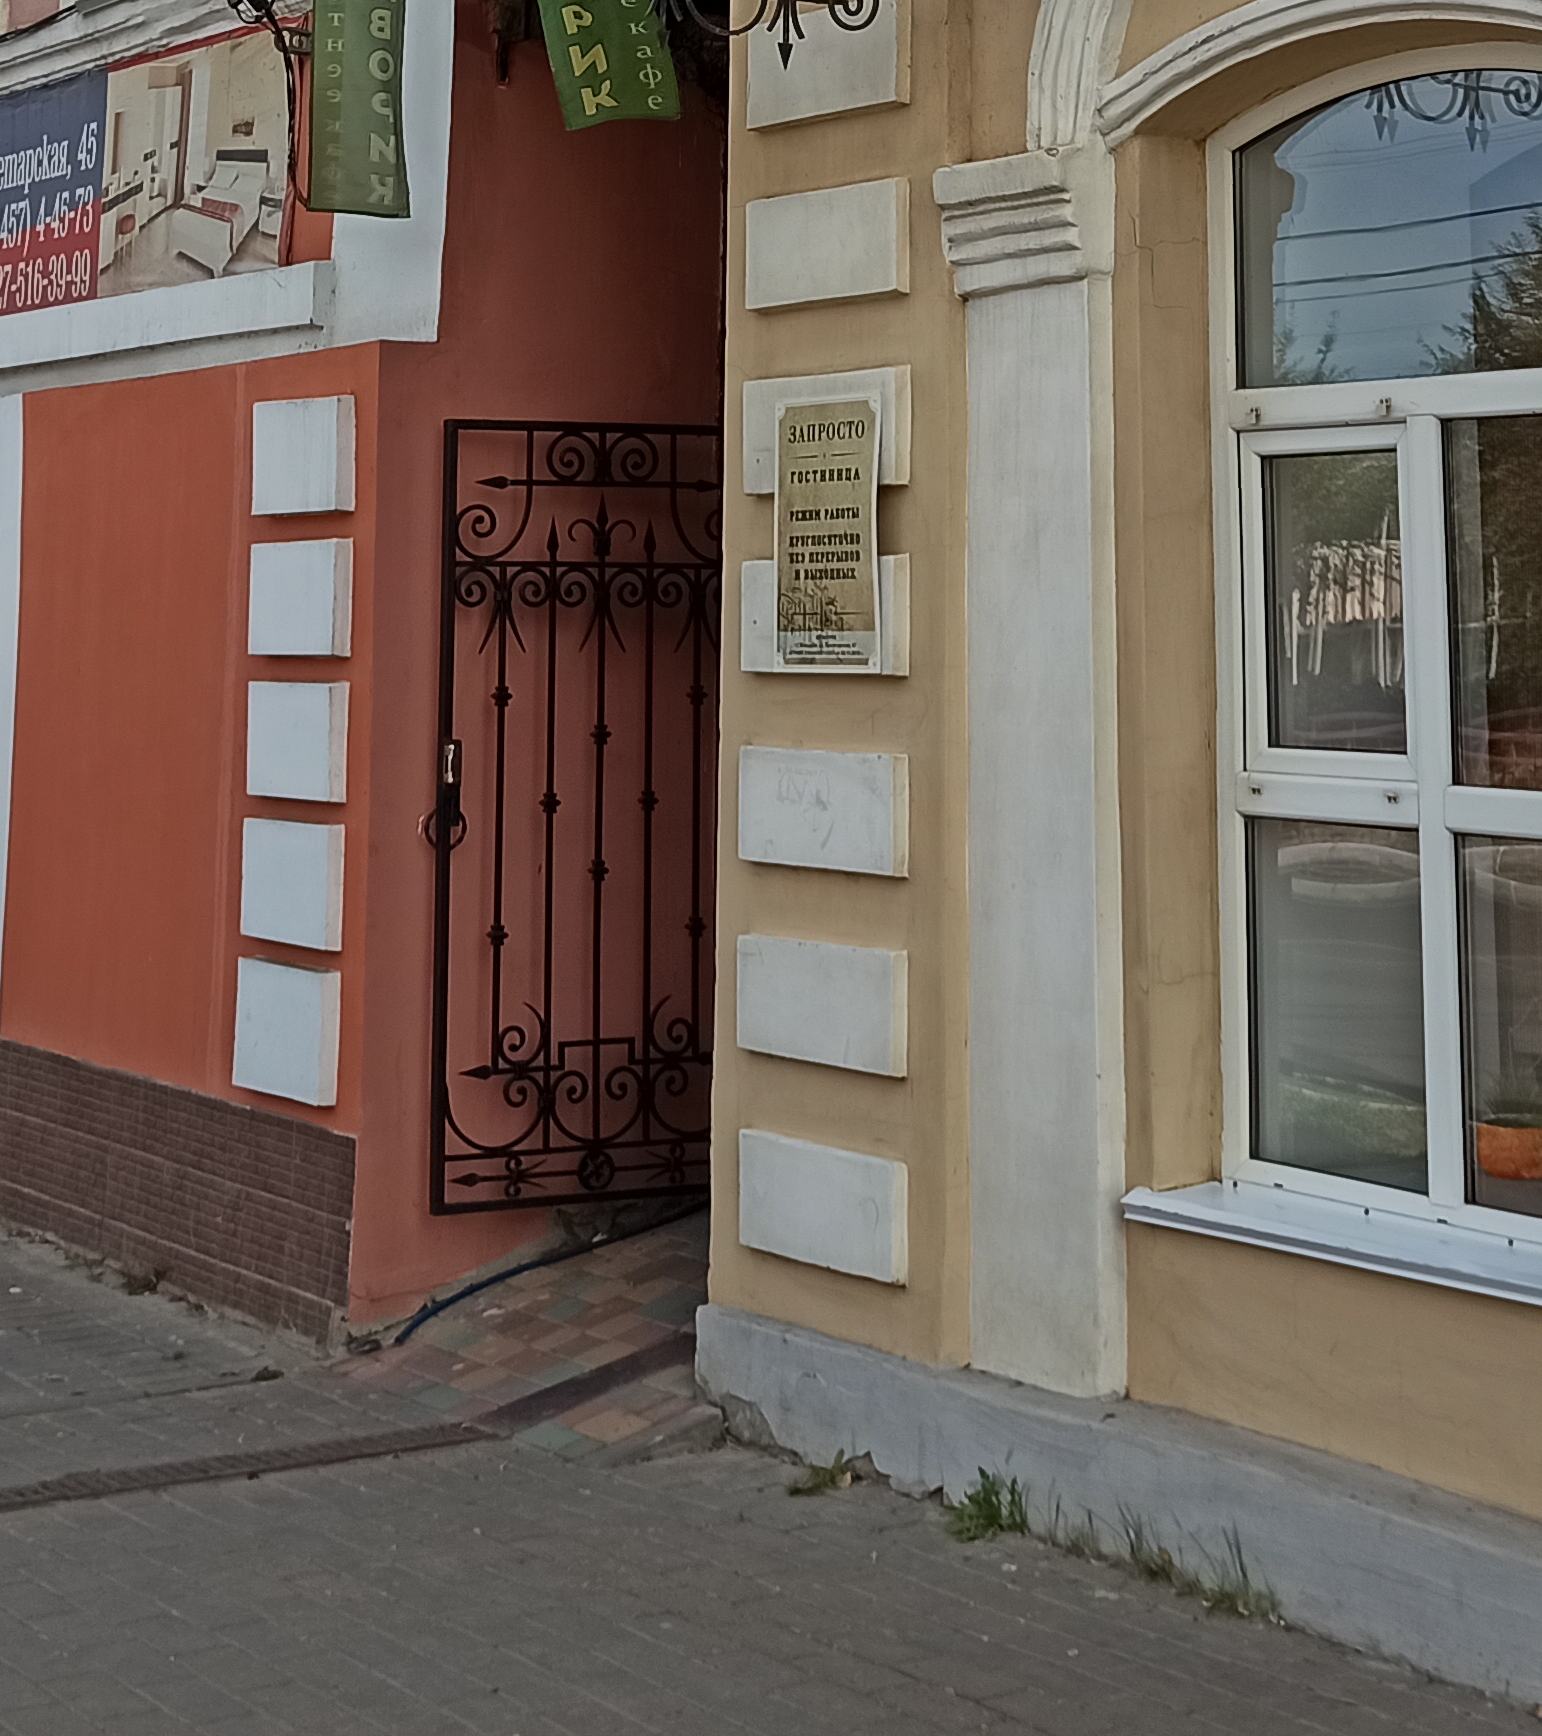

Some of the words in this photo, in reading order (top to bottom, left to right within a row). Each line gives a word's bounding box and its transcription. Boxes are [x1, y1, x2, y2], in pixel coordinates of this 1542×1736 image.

[626, 20, 664, 110] кафе
[77, 121, 98, 171] 45
[35, 185, 95, 243] 4-45-73
[787, 419, 866, 445] ЗАПРОСТО
[790, 467, 861, 485] ГОСТИНИЦА
[789, 509, 821, 522] РЕЖИМ
[824, 506, 860, 520] РАБОТЫ
[788, 532, 861, 548] КРУГЛОСУТОЧНО
[788, 552, 806, 564] БЕЗ
[808, 550, 861, 564] ПЕРЕРЫВОВ
[804, 567, 857, 581] ВЫХОДНЫХ
